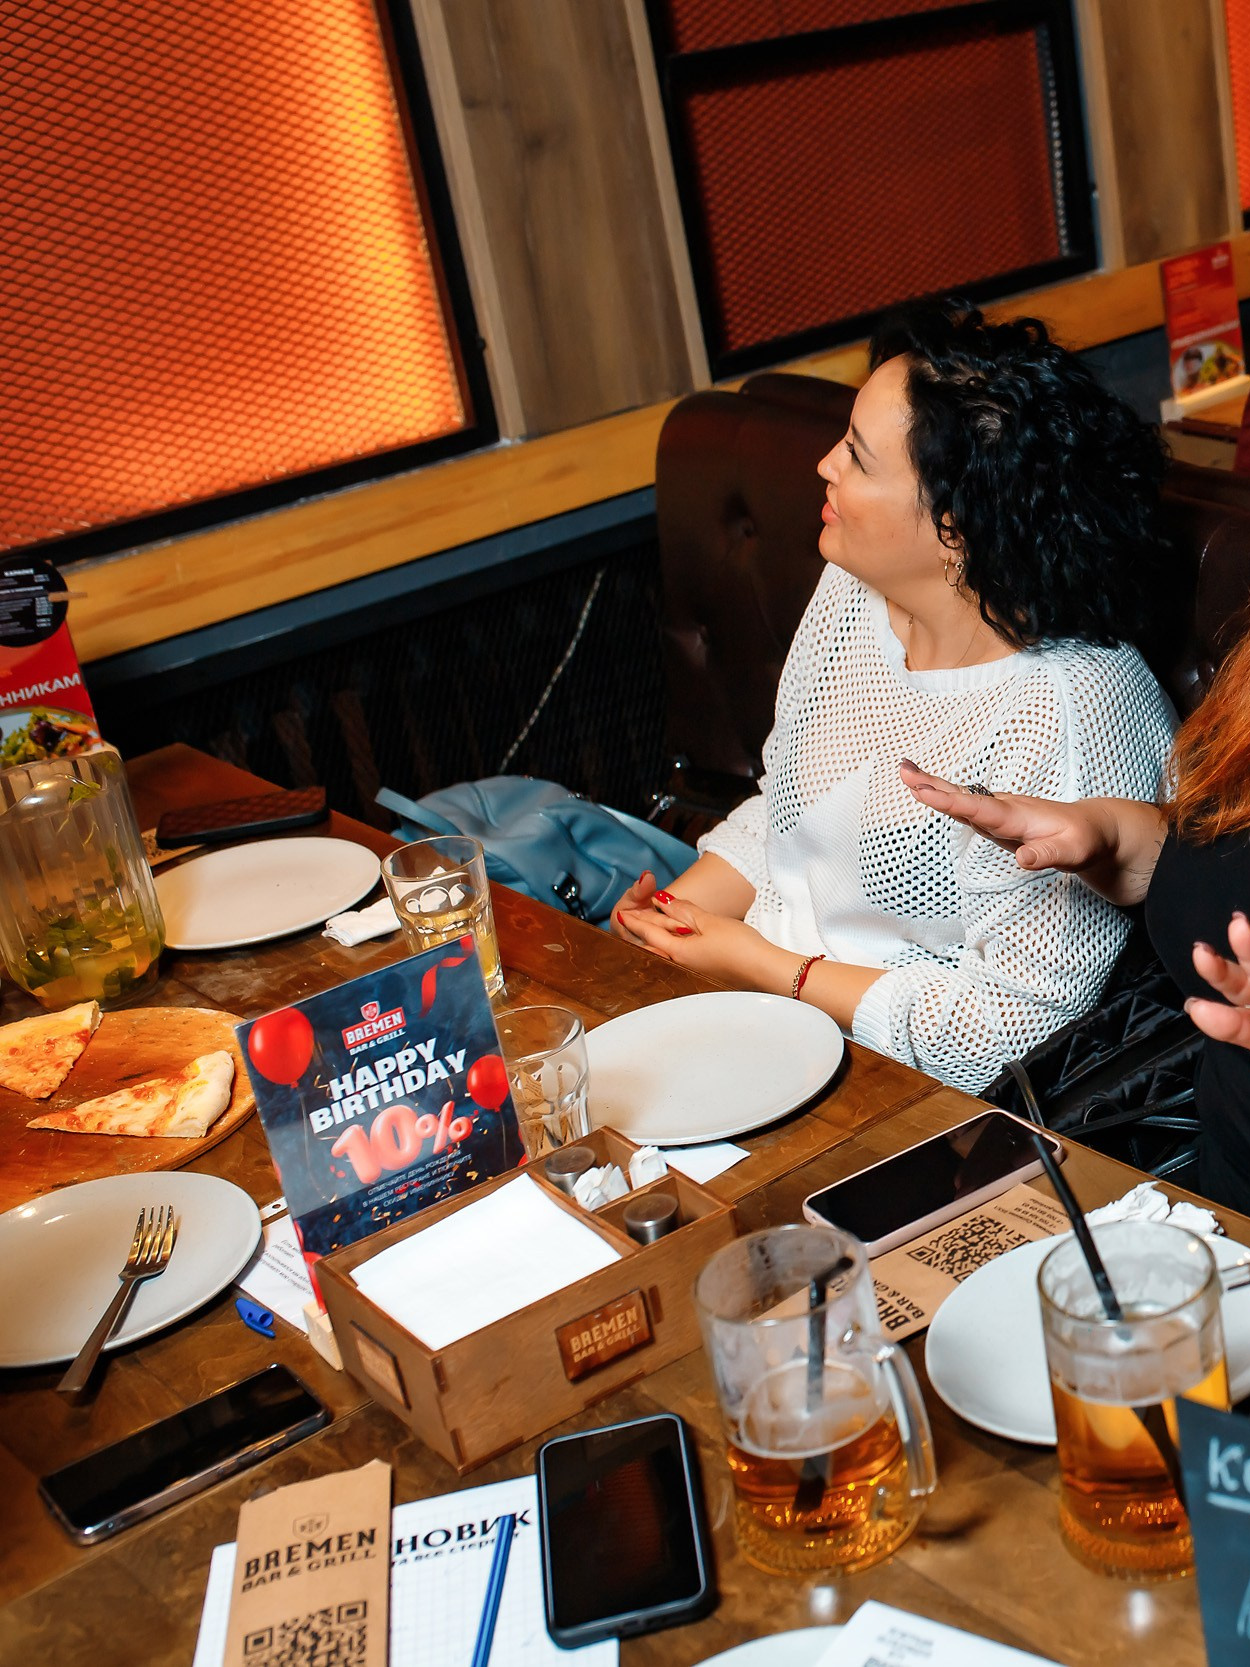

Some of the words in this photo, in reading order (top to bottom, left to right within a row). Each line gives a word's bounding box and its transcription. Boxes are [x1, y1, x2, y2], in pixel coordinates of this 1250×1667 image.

[346, 1012, 403, 1044] BREMEN
[349, 1043, 368, 1056] BAR
[376, 1029, 406, 1044] GRILL
[309, 1049, 467, 1134] BIRTHDAY
[329, 1038, 437, 1101] HAPPY
[331, 1101, 473, 1184] 10%
[570, 1306, 637, 1354] BREMEN
[573, 1346, 596, 1363] BAR
[244, 1528, 377, 1580] BREMEN
[392, 1508, 532, 1556] НОВИК
[241, 1571, 281, 1594] BAR
[306, 1549, 377, 1572] GRILL
